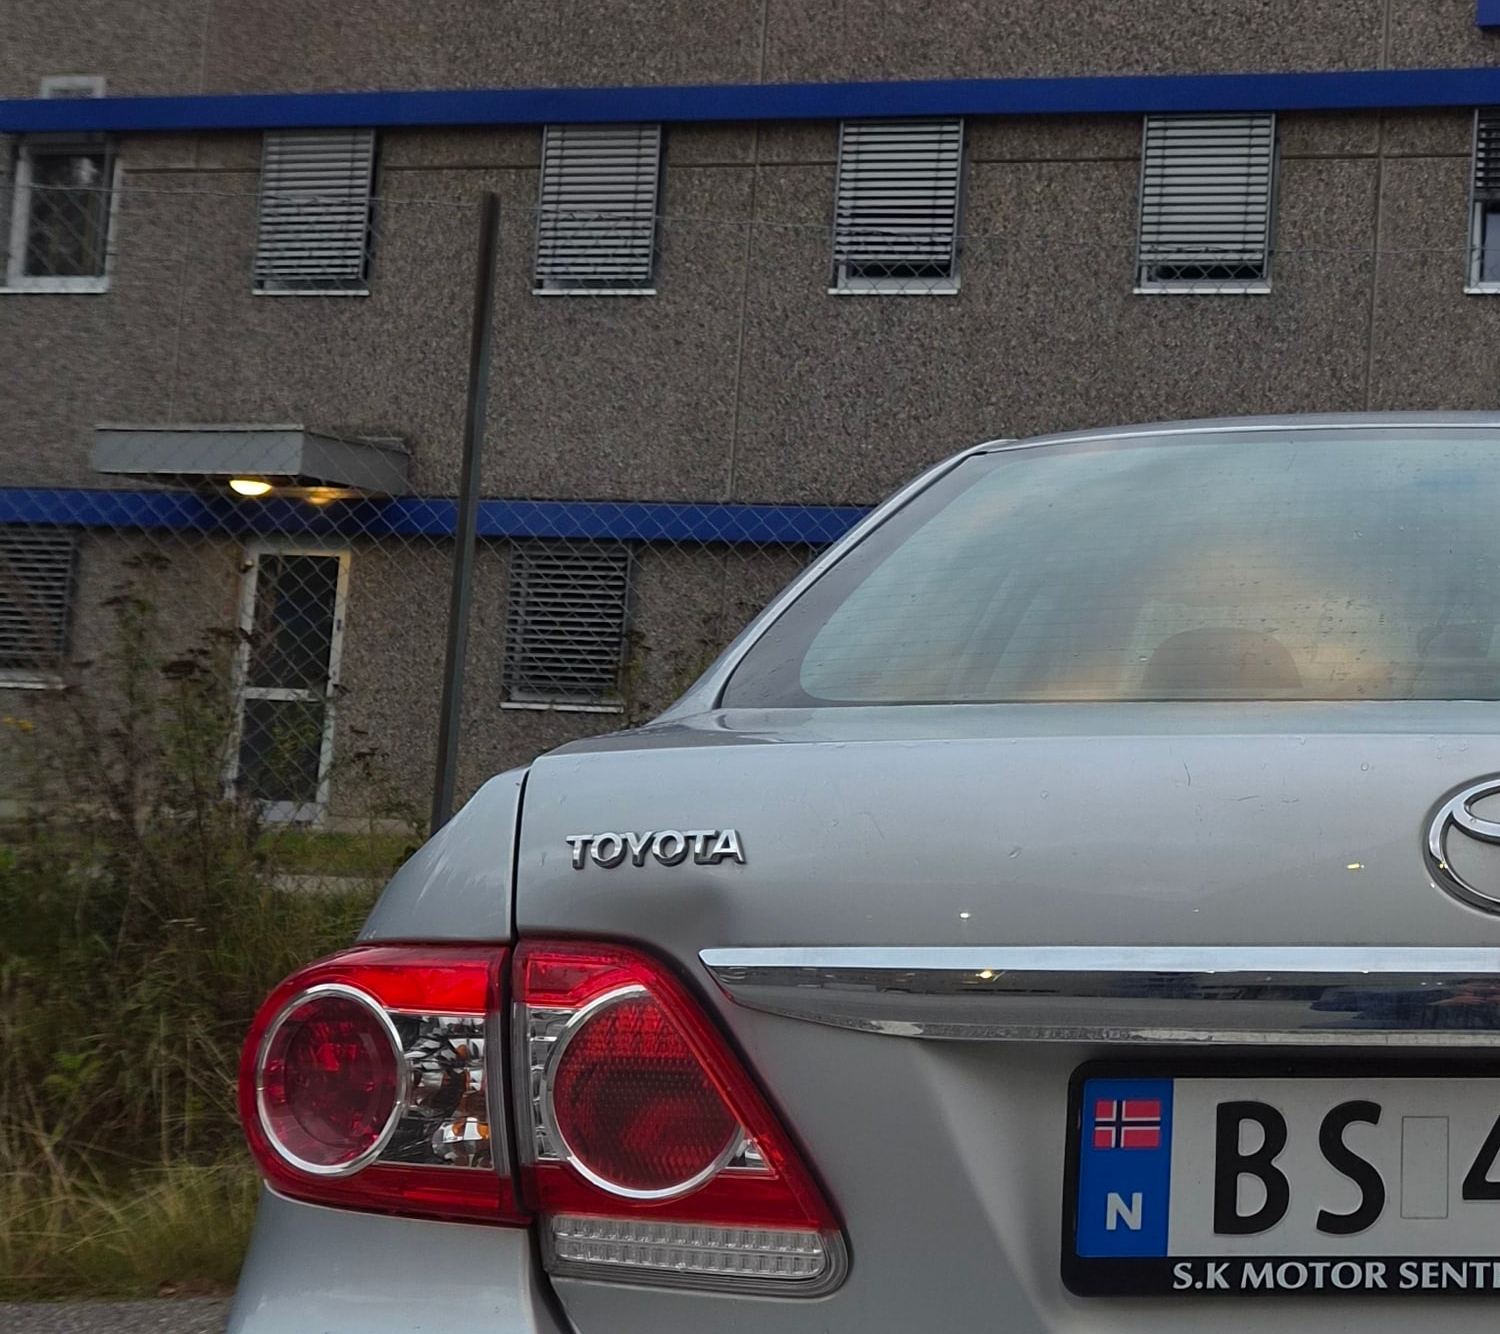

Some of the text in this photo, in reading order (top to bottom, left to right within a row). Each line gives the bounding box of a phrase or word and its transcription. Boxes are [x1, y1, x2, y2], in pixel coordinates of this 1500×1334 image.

[566, 828, 746, 870] TOYOTA
[1213, 1099, 1386, 1236] BS
[1105, 1192, 1143, 1230] N
[1173, 1261, 1231, 1289] S.K
[1240, 1261, 1388, 1289] MOTOR
